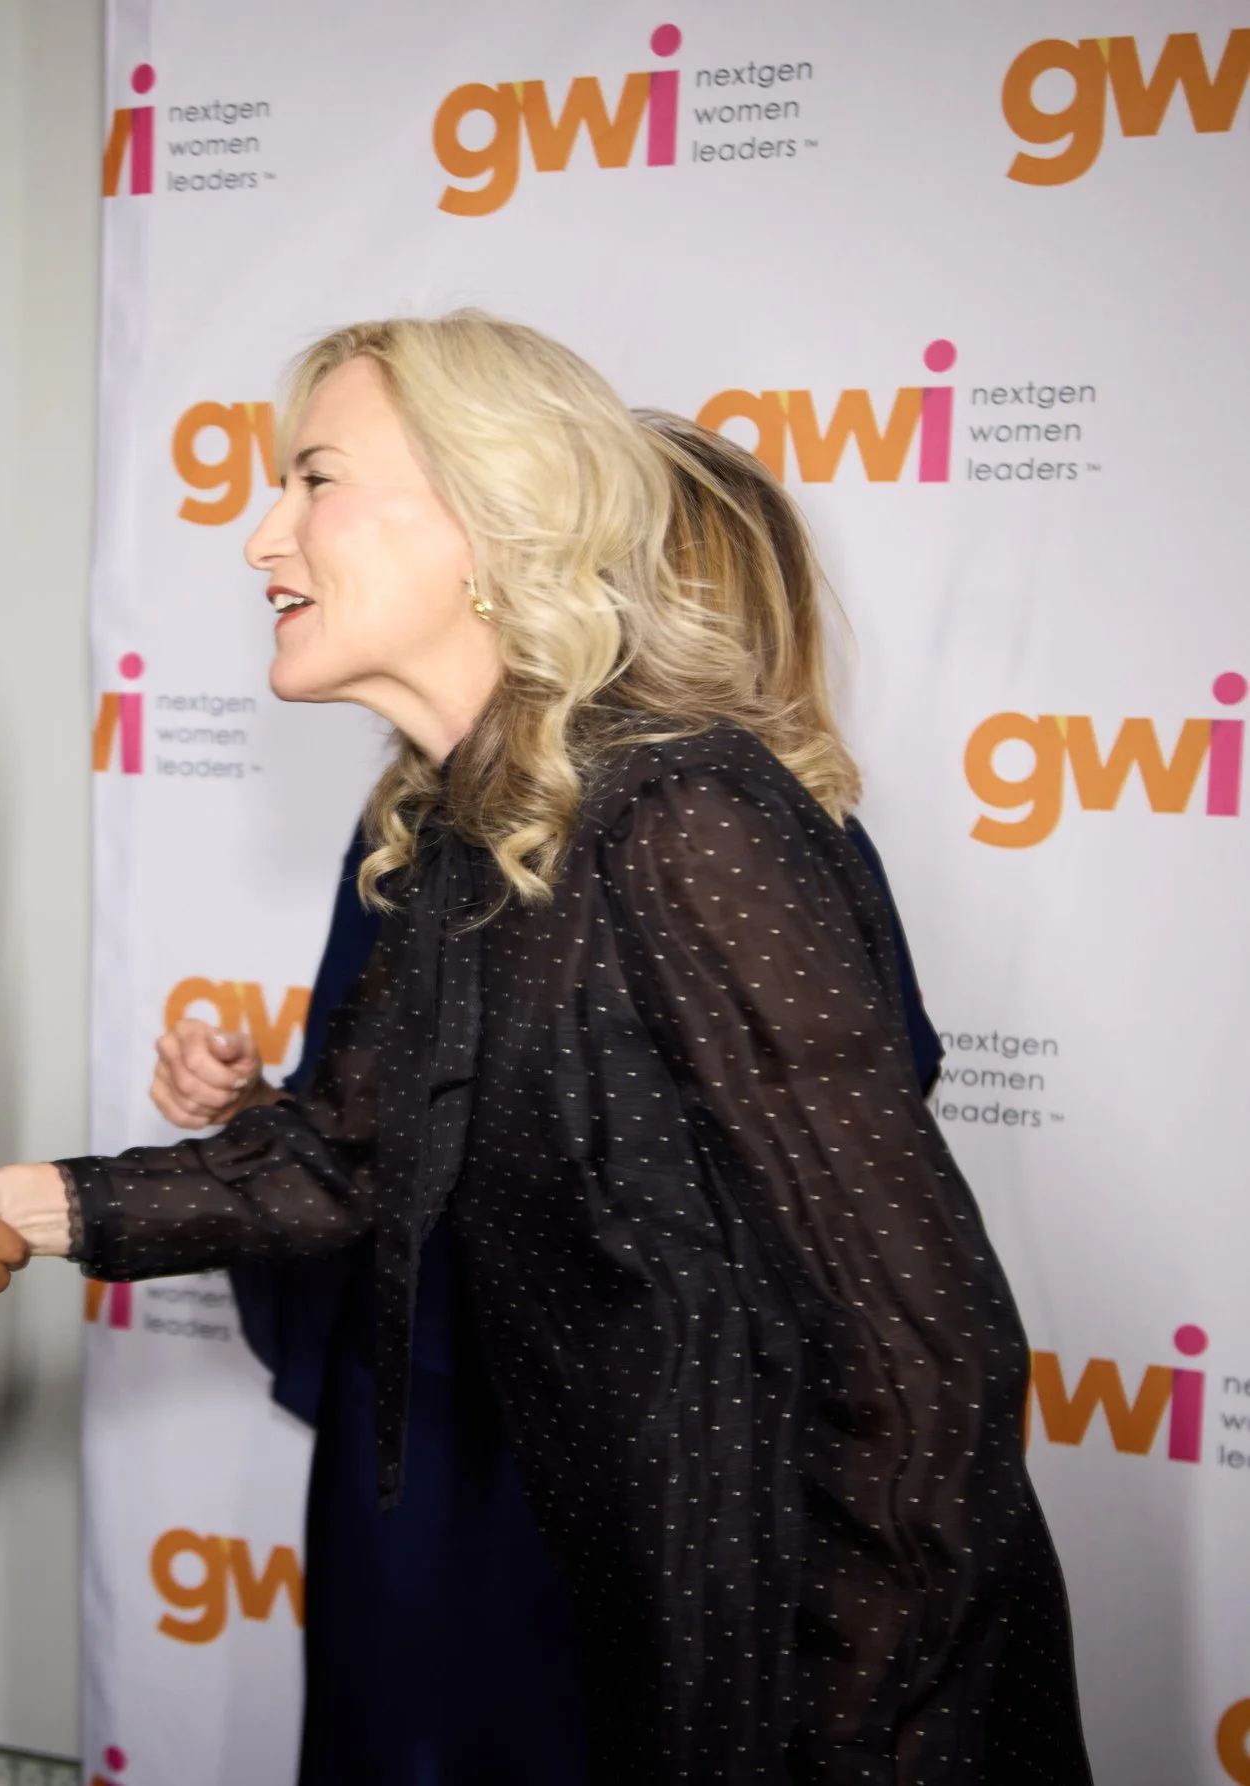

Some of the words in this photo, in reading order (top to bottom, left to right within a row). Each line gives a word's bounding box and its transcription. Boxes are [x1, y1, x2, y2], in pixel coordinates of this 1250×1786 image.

[695, 61, 813, 88] nextgen
[169, 101, 270, 125] nextgen
[433, 24, 682, 216] gwi
[693, 101, 800, 124] women
[102, 63, 156, 197] i
[168, 136, 259, 156] women
[972, 381, 1096, 409] nextgen
[969, 423, 1082, 442] women
[92, 652, 144, 775] i
[156, 693, 257, 717] nextgen
[156, 728, 248, 745] women
[963, 671, 1248, 849] gwi
[939, 1030, 1058, 1059] nextgen
[940, 1068, 1045, 1091] women
[1025, 1323, 1209, 1465] wi
